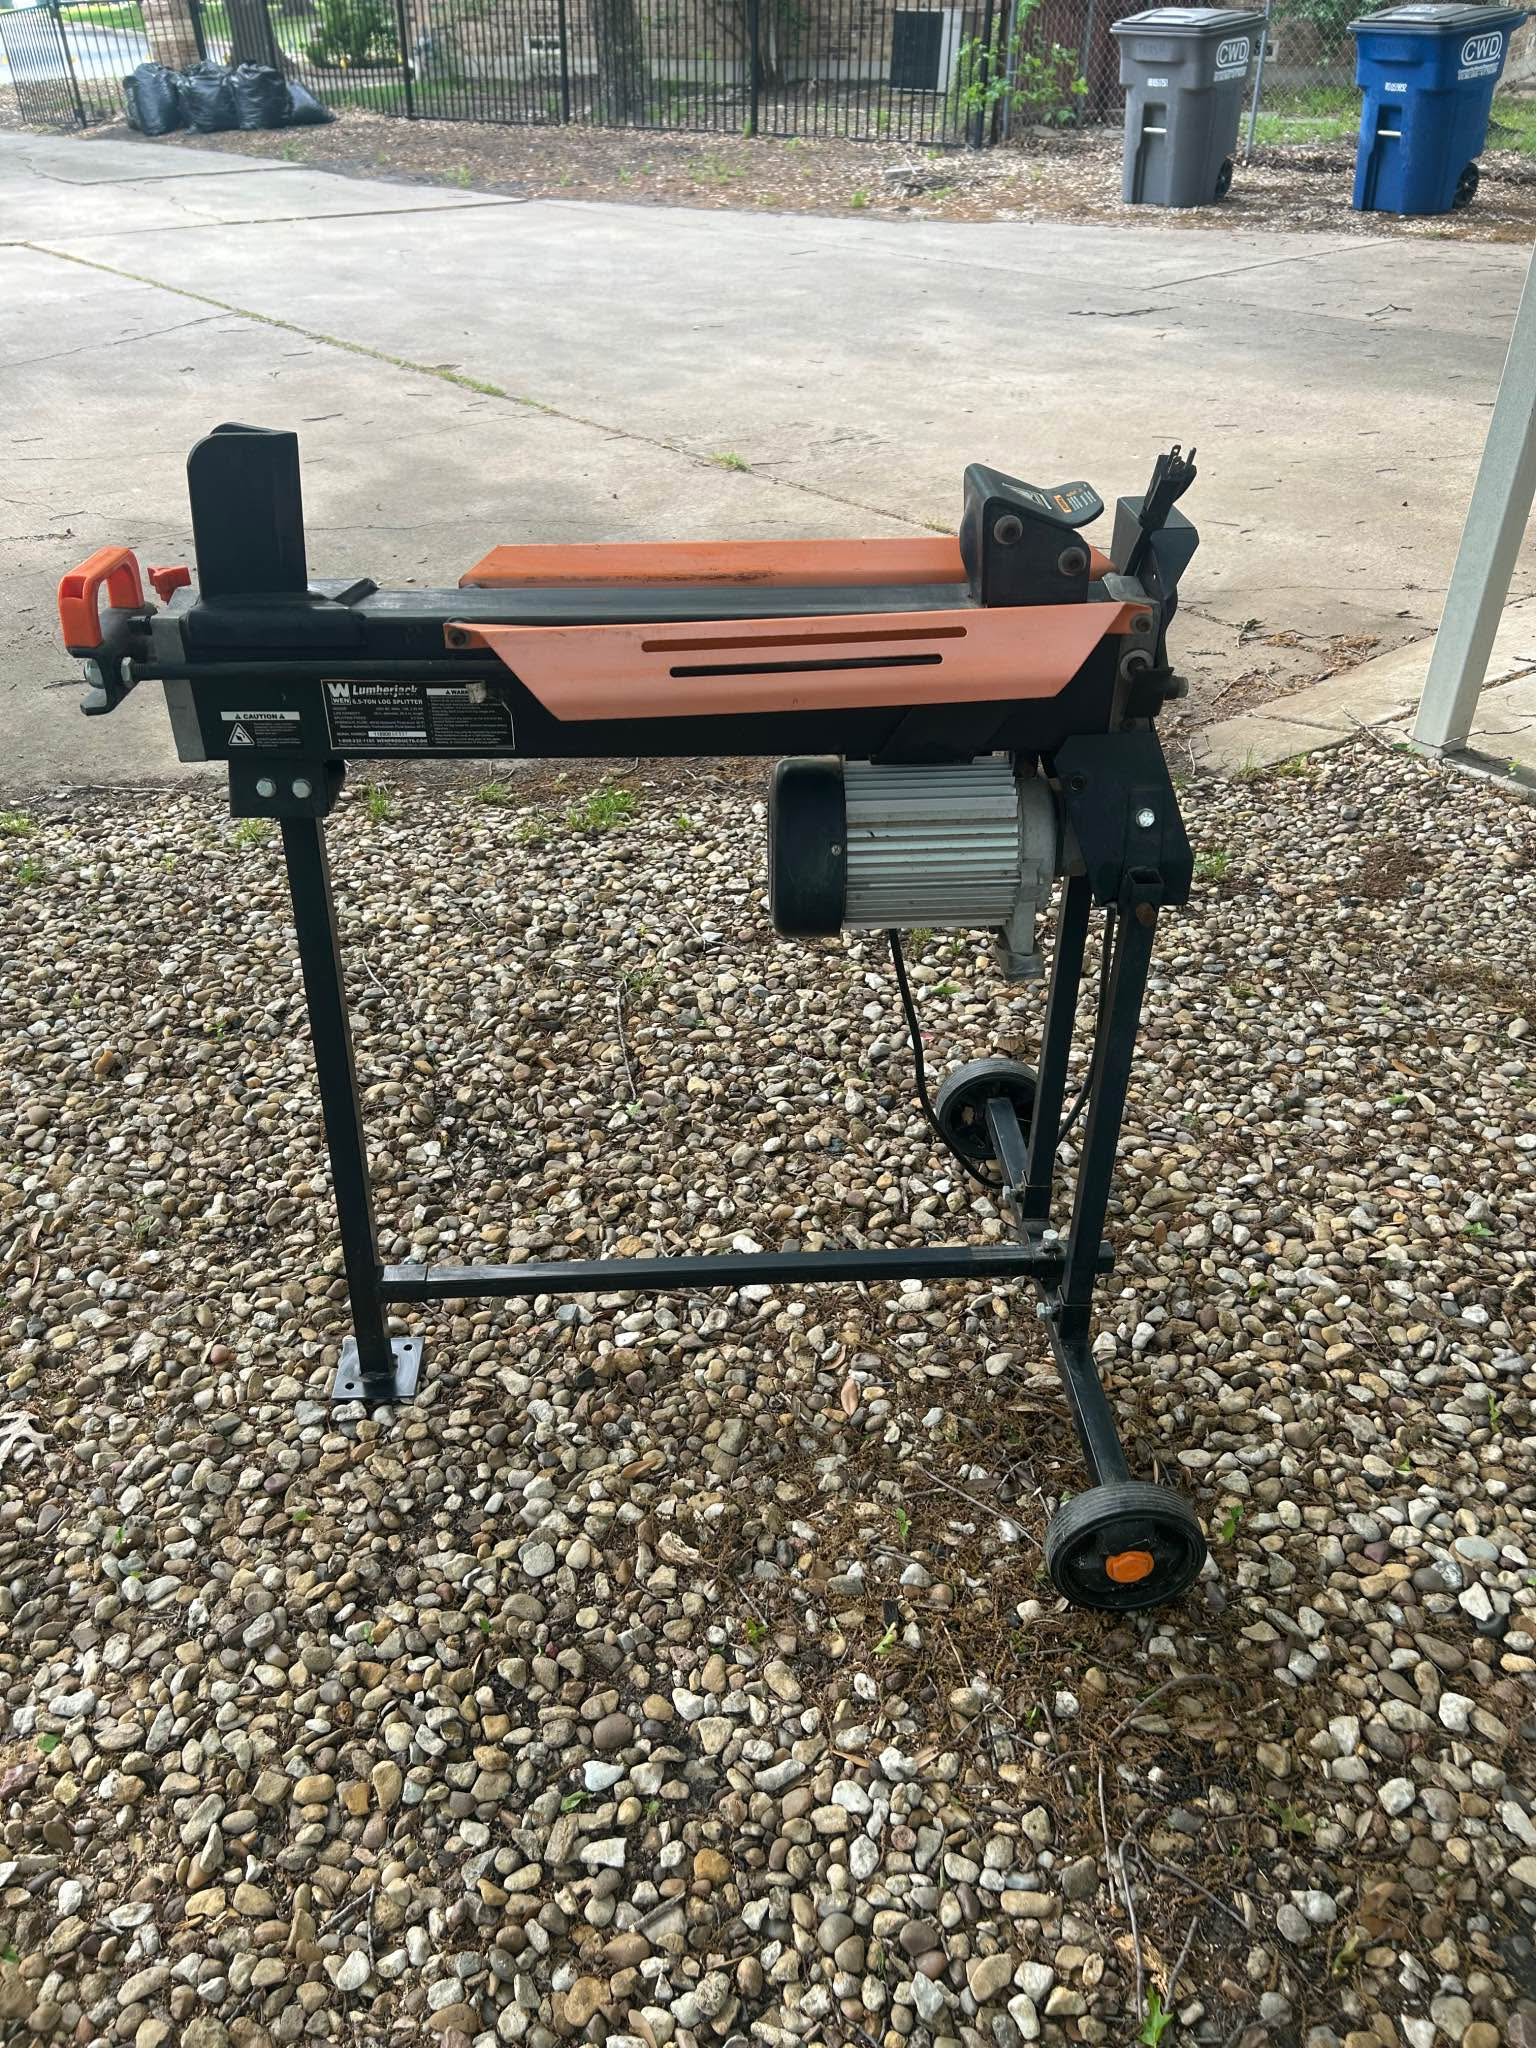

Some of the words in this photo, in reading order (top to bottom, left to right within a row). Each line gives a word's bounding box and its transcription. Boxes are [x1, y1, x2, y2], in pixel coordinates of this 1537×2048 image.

[1219, 42, 1247, 63] CWD
[1465, 36, 1500, 61] CWD
[352, 684, 418, 698] Lumberjack
